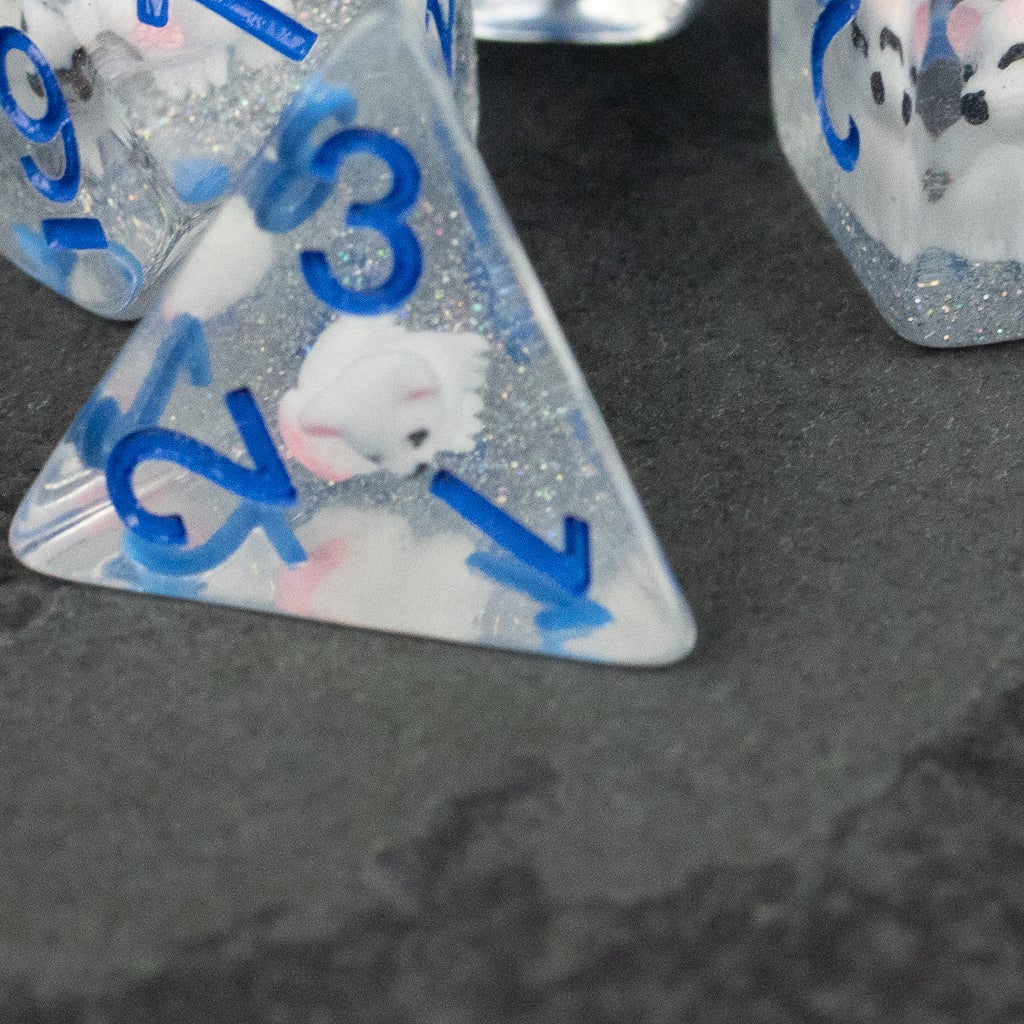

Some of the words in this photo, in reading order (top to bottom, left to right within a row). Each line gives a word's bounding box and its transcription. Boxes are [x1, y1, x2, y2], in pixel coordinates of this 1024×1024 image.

[302, 127, 422, 316] 3
[106, 387, 297, 544] 2
[430, 469, 591, 596] 1
